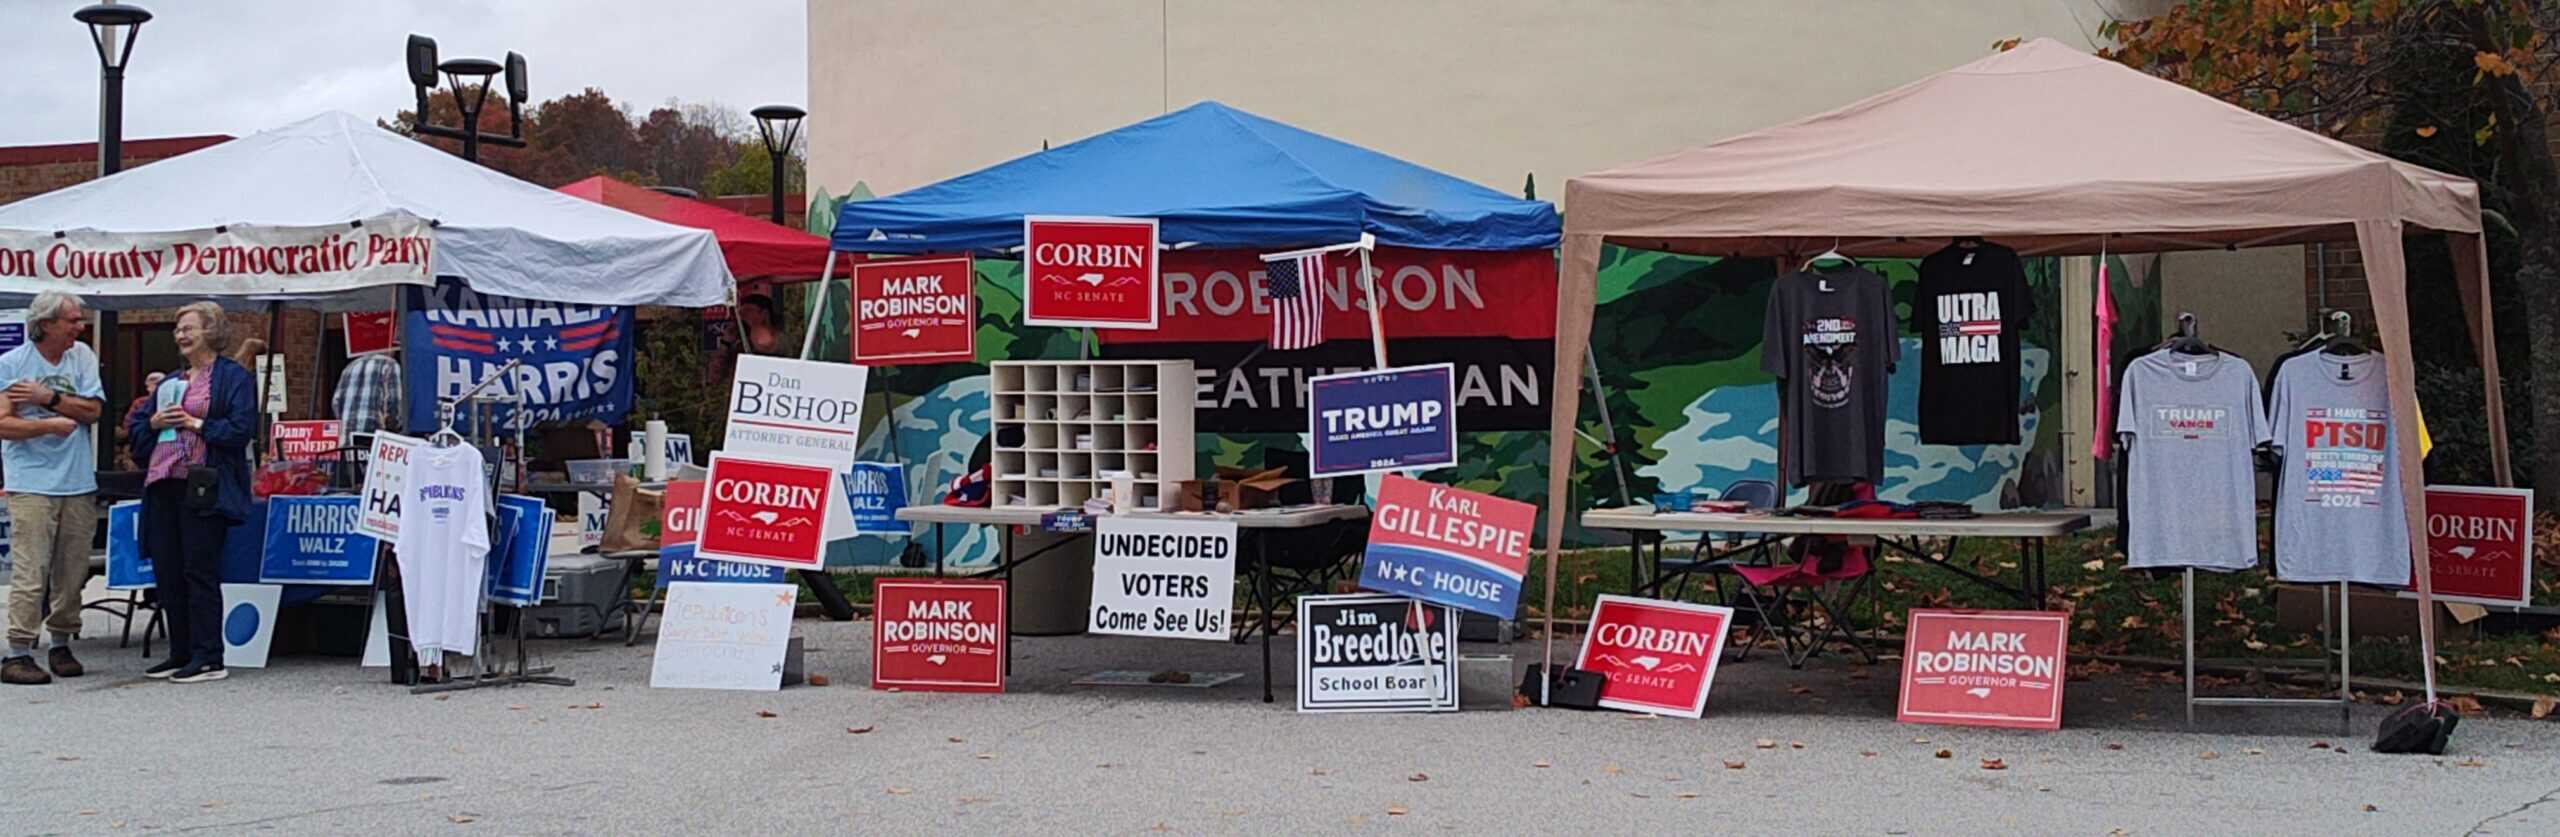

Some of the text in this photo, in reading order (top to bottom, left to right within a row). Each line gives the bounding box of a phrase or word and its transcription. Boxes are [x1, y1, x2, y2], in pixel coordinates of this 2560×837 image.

[46, 243, 163, 286] County
[172, 233, 358, 276] Democratic
[364, 233, 431, 275] Party
[1036, 242, 1145, 269] CORBIN
[882, 275, 943, 296] MARK
[860, 294, 966, 320] ROBINSON
[1054, 291, 1125, 303] NC SENATE
[1936, 291, 2000, 323] ULTRA
[887, 318, 939, 329] GOVERNOR
[1816, 319, 1841, 332] 2ND
[1940, 335, 2001, 365] MAGA
[437, 349, 619, 405] HARRIS
[768, 372, 801, 390] Dan
[732, 380, 858, 424] BISHOP
[2334, 408, 2367, 418] HAVE
[1321, 400, 1442, 434] TRUMP
[2157, 408, 2226, 420] TRUMP
[2169, 420, 2215, 429] VANCE
[275, 424, 314, 441] Danny
[729, 429, 852, 451] ATTORNEY GENERAL
[2305, 420, 2386, 451] PTSD
[715, 478, 822, 511] CORBIN
[2321, 494, 2361, 508] 2024
[286, 503, 360, 534] HARRIS
[2427, 513, 2517, 543] ORBIN
[726, 526, 796, 543] NC SENATE
[1377, 503, 1525, 559] GILLESPIE
[298, 537, 346, 554] WALZ
[1100, 533, 1229, 560] UNDECIDED
[717, 561, 772, 578] HOUSE
[1121, 573, 1209, 598] VOTERS
[1432, 570, 1503, 603] HOUSE
[907, 600, 973, 620] MARK
[1096, 605, 1225, 633] Come See Us!
[1335, 609, 1378, 626] Jim
[884, 620, 996, 645] ROBINSON
[1596, 622, 1711, 657] CORBIN
[1947, 631, 2027, 653] MARK
[911, 643, 967, 654] GOVERNOR
[1916, 651, 2054, 679] ROBINSON
[1319, 676, 1379, 691] School
[1626, 672, 1675, 689] SENATE
[1949, 675, 2017, 688] GOVERNOR
